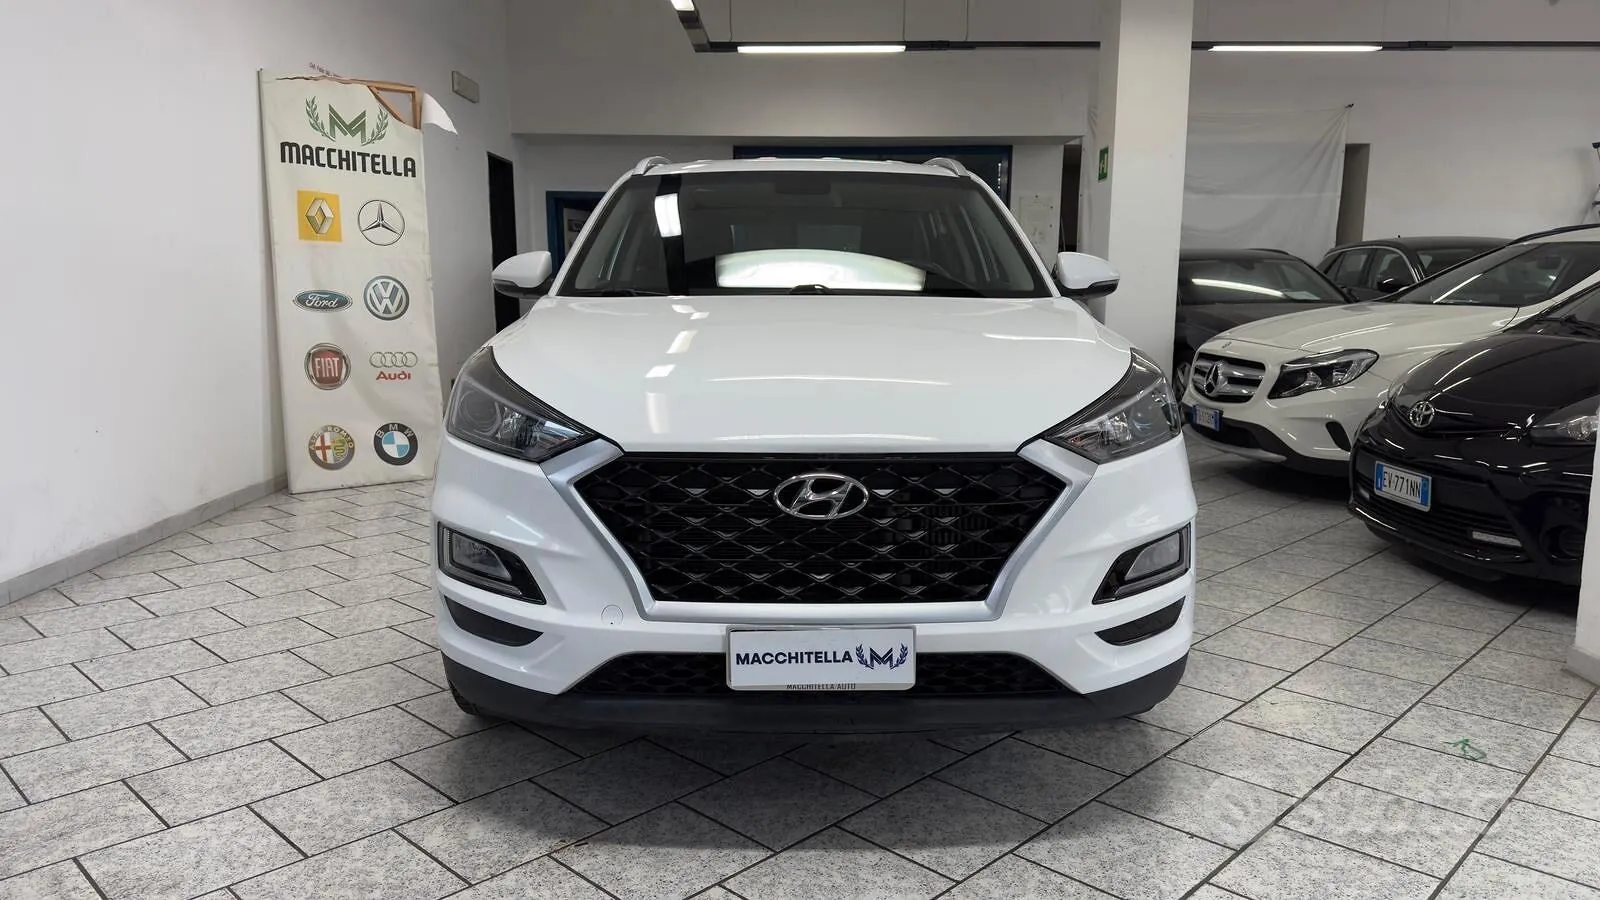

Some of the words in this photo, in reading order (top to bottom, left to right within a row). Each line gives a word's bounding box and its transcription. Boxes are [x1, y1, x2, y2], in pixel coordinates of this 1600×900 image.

[280, 141, 417, 178] MACCHITELLA
[305, 292, 338, 308] Ford
[314, 357, 341, 377] FIAT
[376, 370, 411, 381] Audi
[375, 423, 415, 439] BMW
[735, 651, 854, 666] MACCHITELLA
